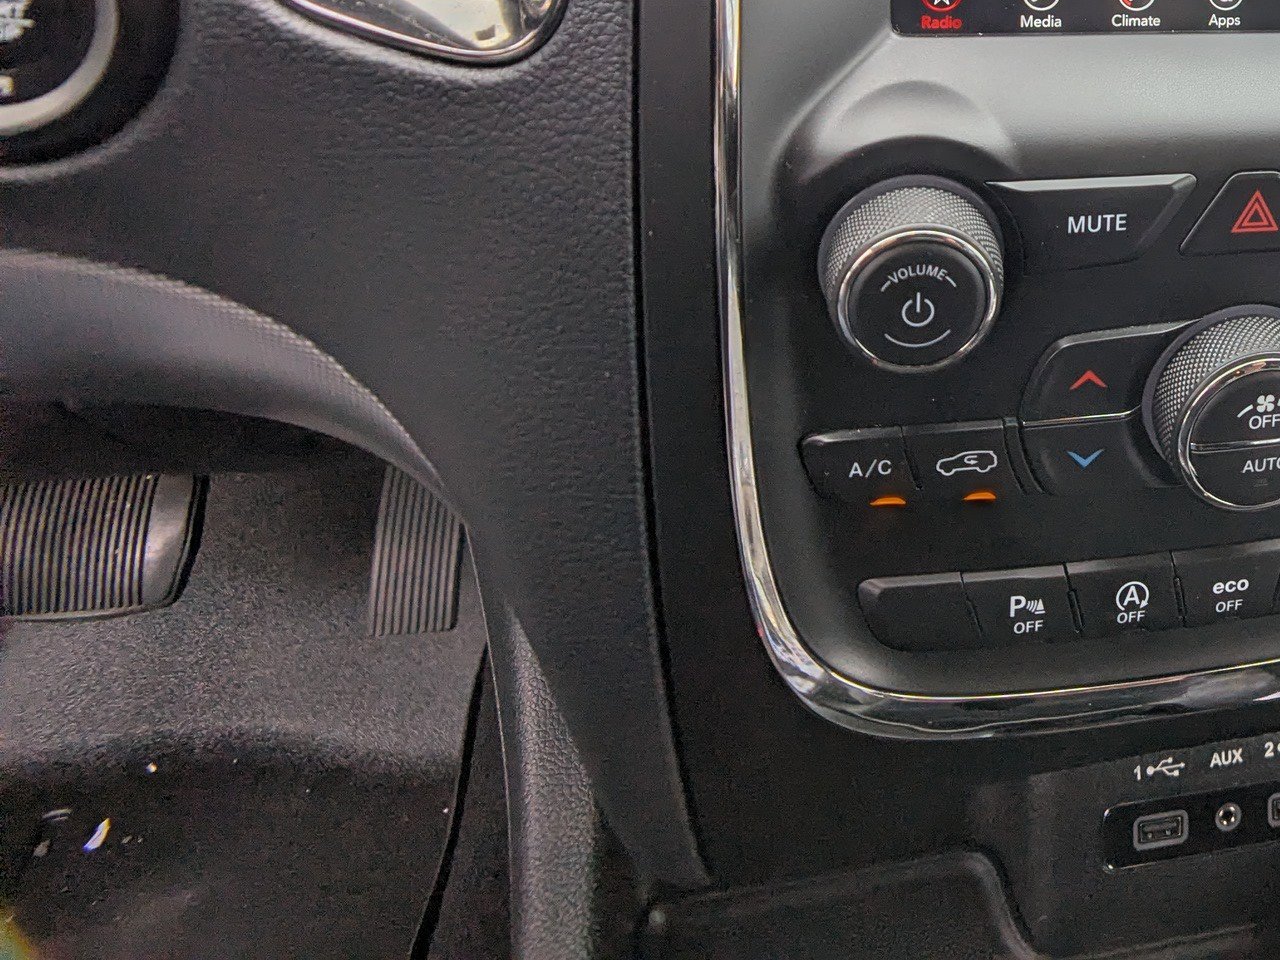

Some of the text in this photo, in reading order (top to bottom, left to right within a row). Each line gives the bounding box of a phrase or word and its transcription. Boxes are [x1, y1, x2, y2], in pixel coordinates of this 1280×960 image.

[921, 14, 962, 29] Radio
[1020, 14, 1062, 28] Media
[1111, 14, 1161, 27] Climate
[1208, 14, 1241, 28] Apps
[1068, 214, 1127, 233] MUTE
[888, 264, 946, 283] VOLUME
[1249, 414, 1280, 429] OFF
[849, 459, 891, 477] A/C
[1213, 579, 1249, 594] eco
[1216, 599, 1243, 612] OFF
[1116, 611, 1146, 624] OFF
[1014, 620, 1043, 633] OFF
[1265, 742, 1274, 757] 2
[1210, 748, 1242, 767] AUX
[1134, 766, 1141, 780] 1
